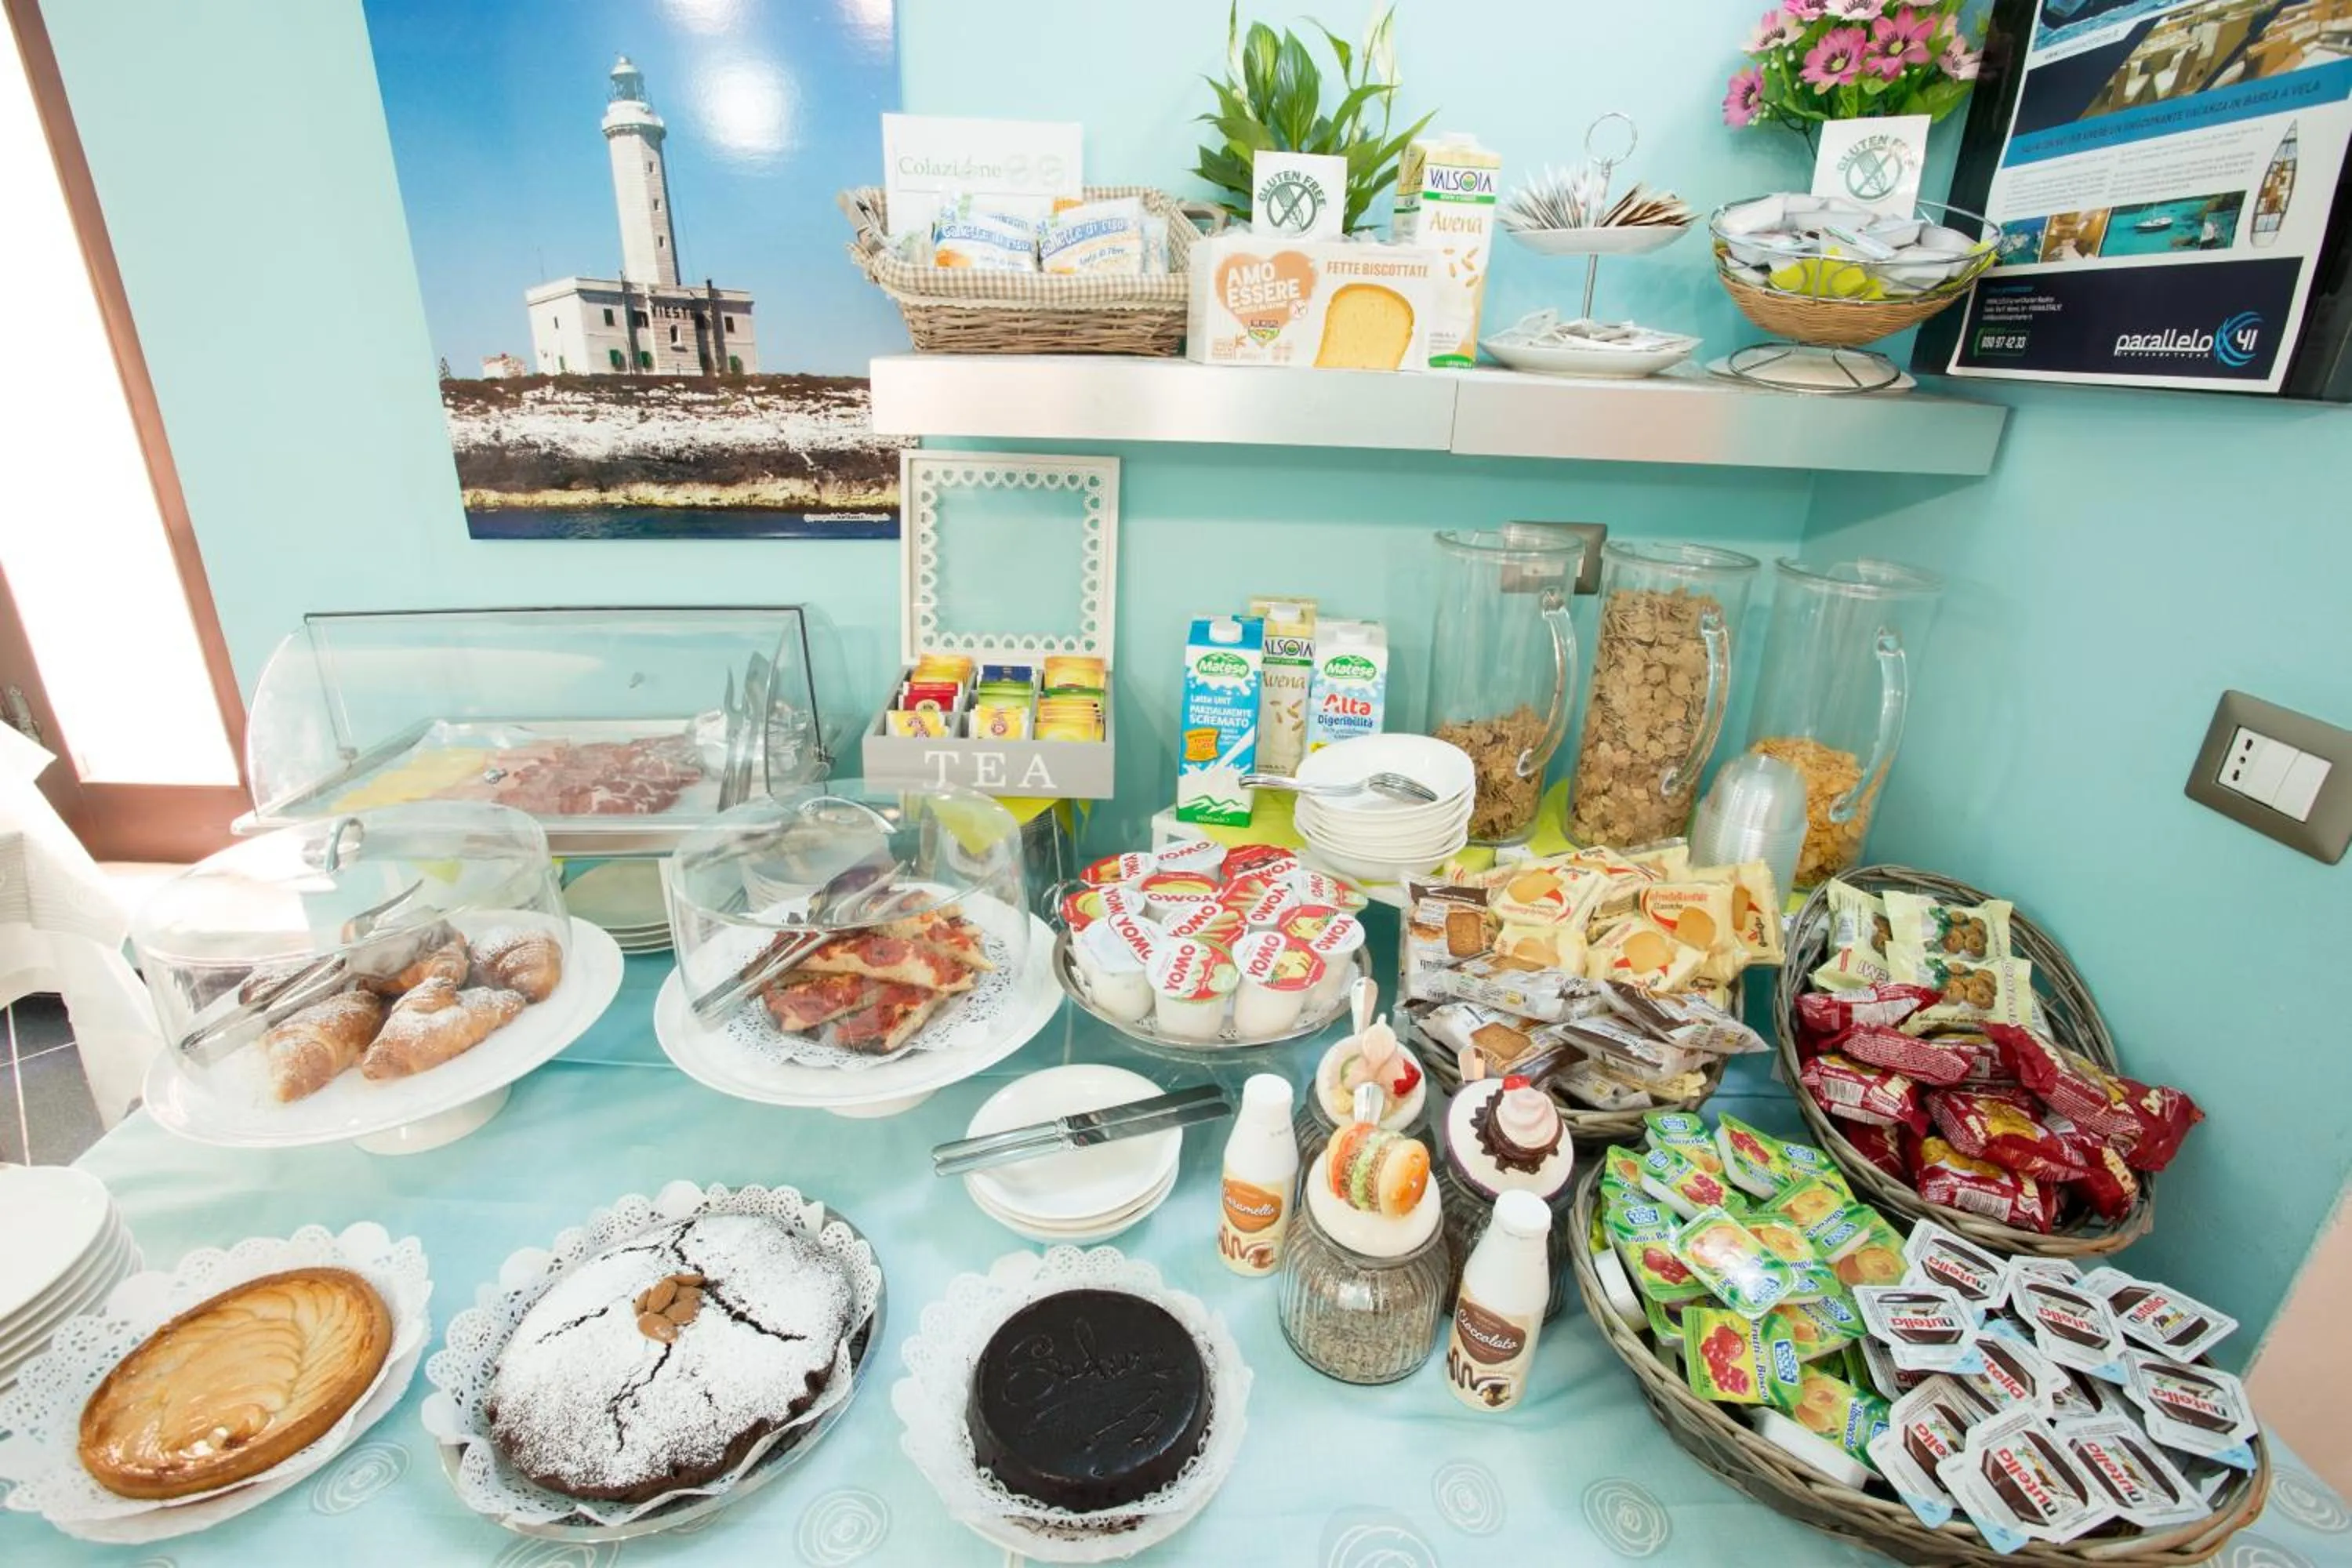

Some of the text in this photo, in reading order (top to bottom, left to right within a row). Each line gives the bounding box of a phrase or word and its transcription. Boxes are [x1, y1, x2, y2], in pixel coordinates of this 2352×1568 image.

[1258, 170, 1327, 206] GLUTEN FREE
[1429, 168, 1493, 192] VALSOIA
[1429, 211, 1483, 234] Avena
[1228, 262, 1276, 287] AMO
[1327, 261, 1430, 278] FETTE BISCOTTATE
[1227, 278, 1301, 309] ESSERE
[2114, 328, 2259, 357] parallelo 41
[1264, 639, 1313, 658] ALSOIA
[1323, 693, 1372, 716] Alta
[1189, 714, 1250, 728] SCREMATO
[924, 750, 1057, 789] TEA
[1158, 840, 1210, 861] YOMO
[1104, 887, 1127, 916] YOM
[1148, 893, 1214, 902] YOMO
[1250, 887, 1290, 921] YOMO
[1167, 906, 1217, 938] YOMO
[1316, 919, 1355, 951] YOMO
[1163, 944, 1196, 990] YOMO
[1246, 934, 1281, 978] YOMO
[1927, 1254, 1987, 1290] nutella
[1889, 1316, 1955, 1329] nutella
[2038, 1306, 2100, 1334] nutella
[2127, 1296, 2169, 1324] nutella
[1458, 1308, 1519, 1349] Cioccolato
[1982, 1357, 2025, 1400] tella
[2151, 1387, 2227, 1417] nutella
[1915, 1422, 1947, 1457] ella
[1998, 1448, 2059, 1517] nutella
[2085, 1442, 2143, 1503] nutella
